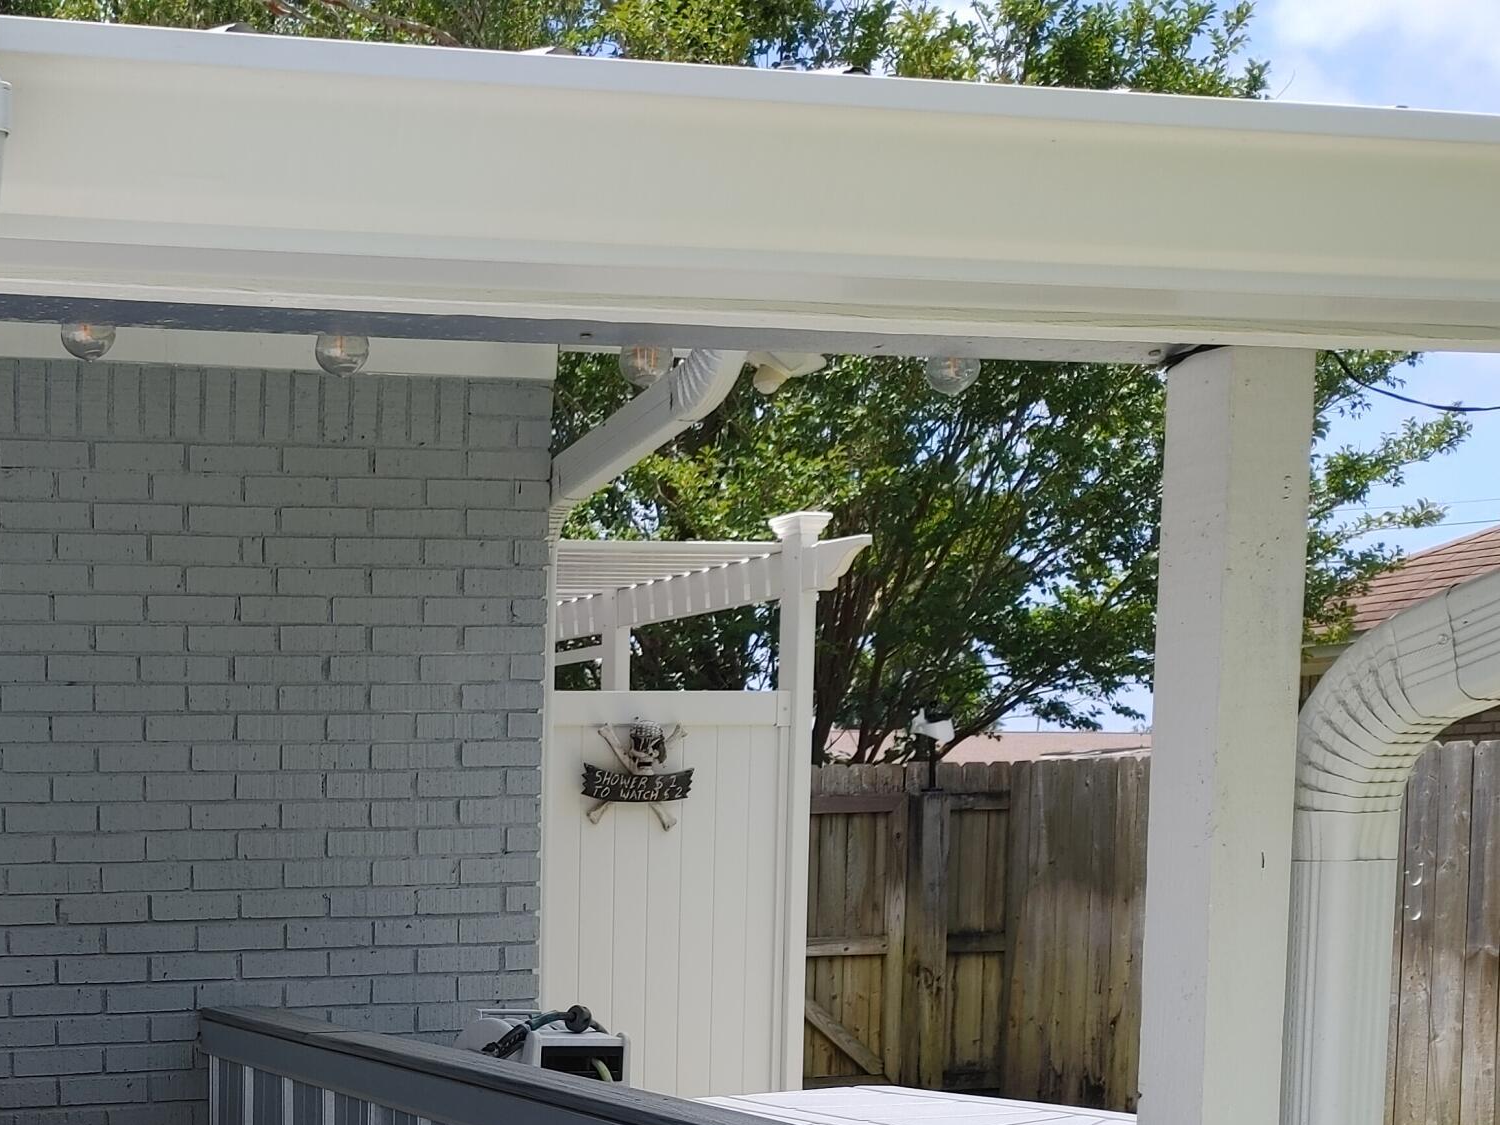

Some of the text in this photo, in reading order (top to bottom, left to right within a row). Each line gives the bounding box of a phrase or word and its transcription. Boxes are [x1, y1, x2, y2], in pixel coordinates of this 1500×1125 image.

[595, 771, 648, 789] SHOWER
[593, 785, 611, 797] TO
[620, 789, 659, 800] WATCH
